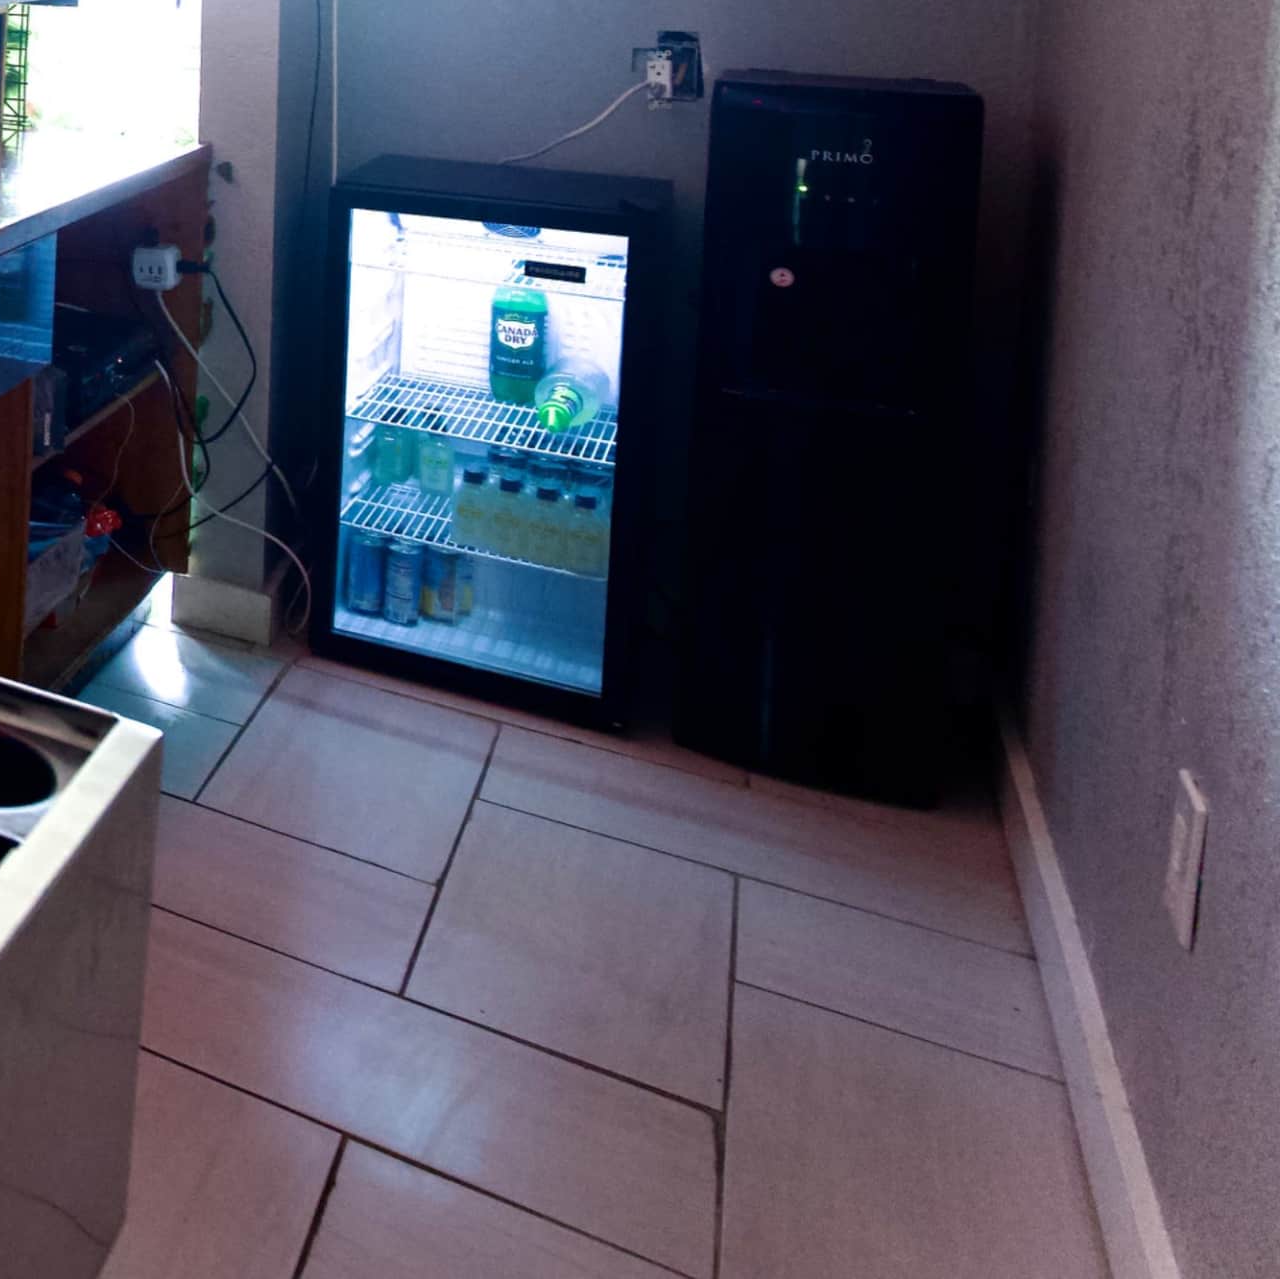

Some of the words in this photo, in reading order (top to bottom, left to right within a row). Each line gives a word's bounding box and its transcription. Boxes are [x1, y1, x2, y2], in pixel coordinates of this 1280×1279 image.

[811, 148, 874, 165] PRIMO
[497, 323, 539, 337] CANADA
[504, 335, 528, 345] DRY
